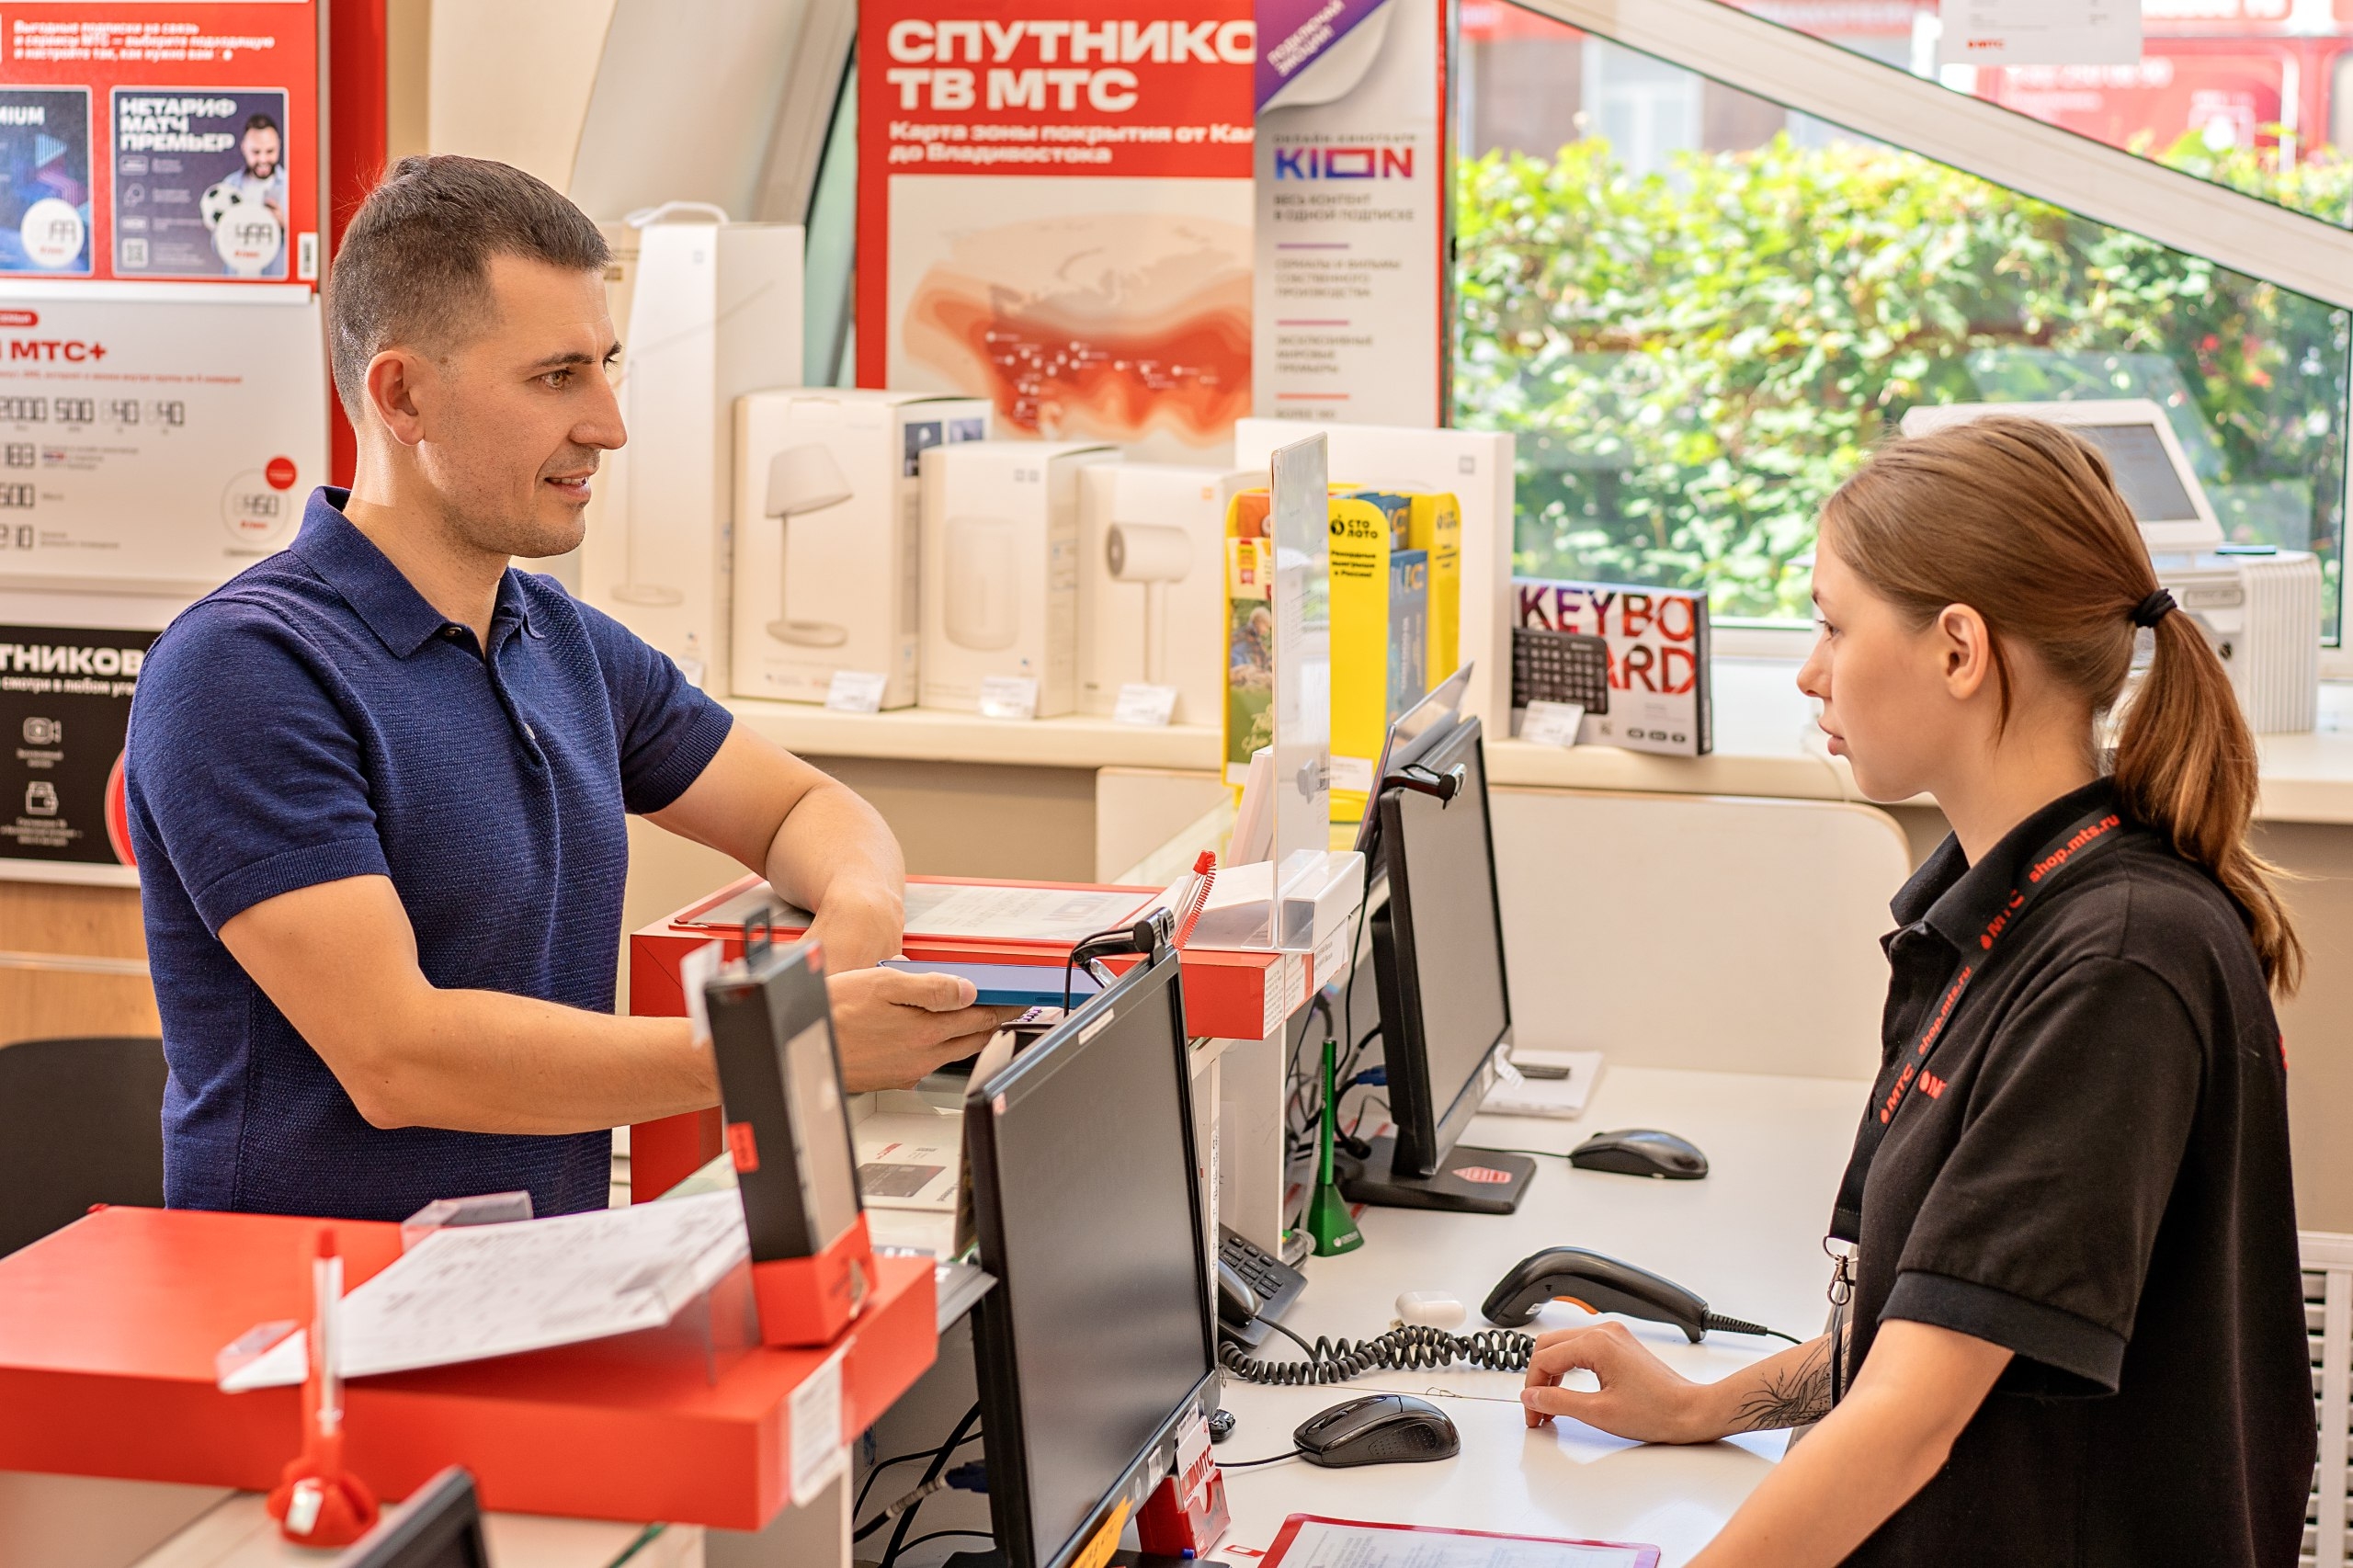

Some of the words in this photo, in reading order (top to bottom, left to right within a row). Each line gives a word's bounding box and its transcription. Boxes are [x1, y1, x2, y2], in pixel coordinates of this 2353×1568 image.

[887, 68, 976, 110] ТВ
[986, 68, 1139, 112] МТС
[119, 97, 237, 118] НЕТАРИФ
[119, 116, 189, 133] МАТЧ
[888, 120, 966, 144] Карта
[970, 125, 1037, 142] зоны
[1040, 125, 1171, 146] покрытия
[1175, 126, 1209, 143] от
[119, 133, 235, 152] ПРЕМЬЕР
[888, 144, 924, 164] до
[926, 142, 1113, 165] Владивостока
[1275, 147, 1414, 180] KION
[11, 341, 106, 361] МТС+
[1347, 518, 1370, 528] СТО
[1347, 529, 1378, 539] ЛОТО
[2029, 814, 2120, 883] shop.mts.ru
[1918, 966, 1972, 1055] shop.mts.ru
[1886, 1062, 1914, 1111] МТС
[1195, 1444, 1214, 1479] МТС
